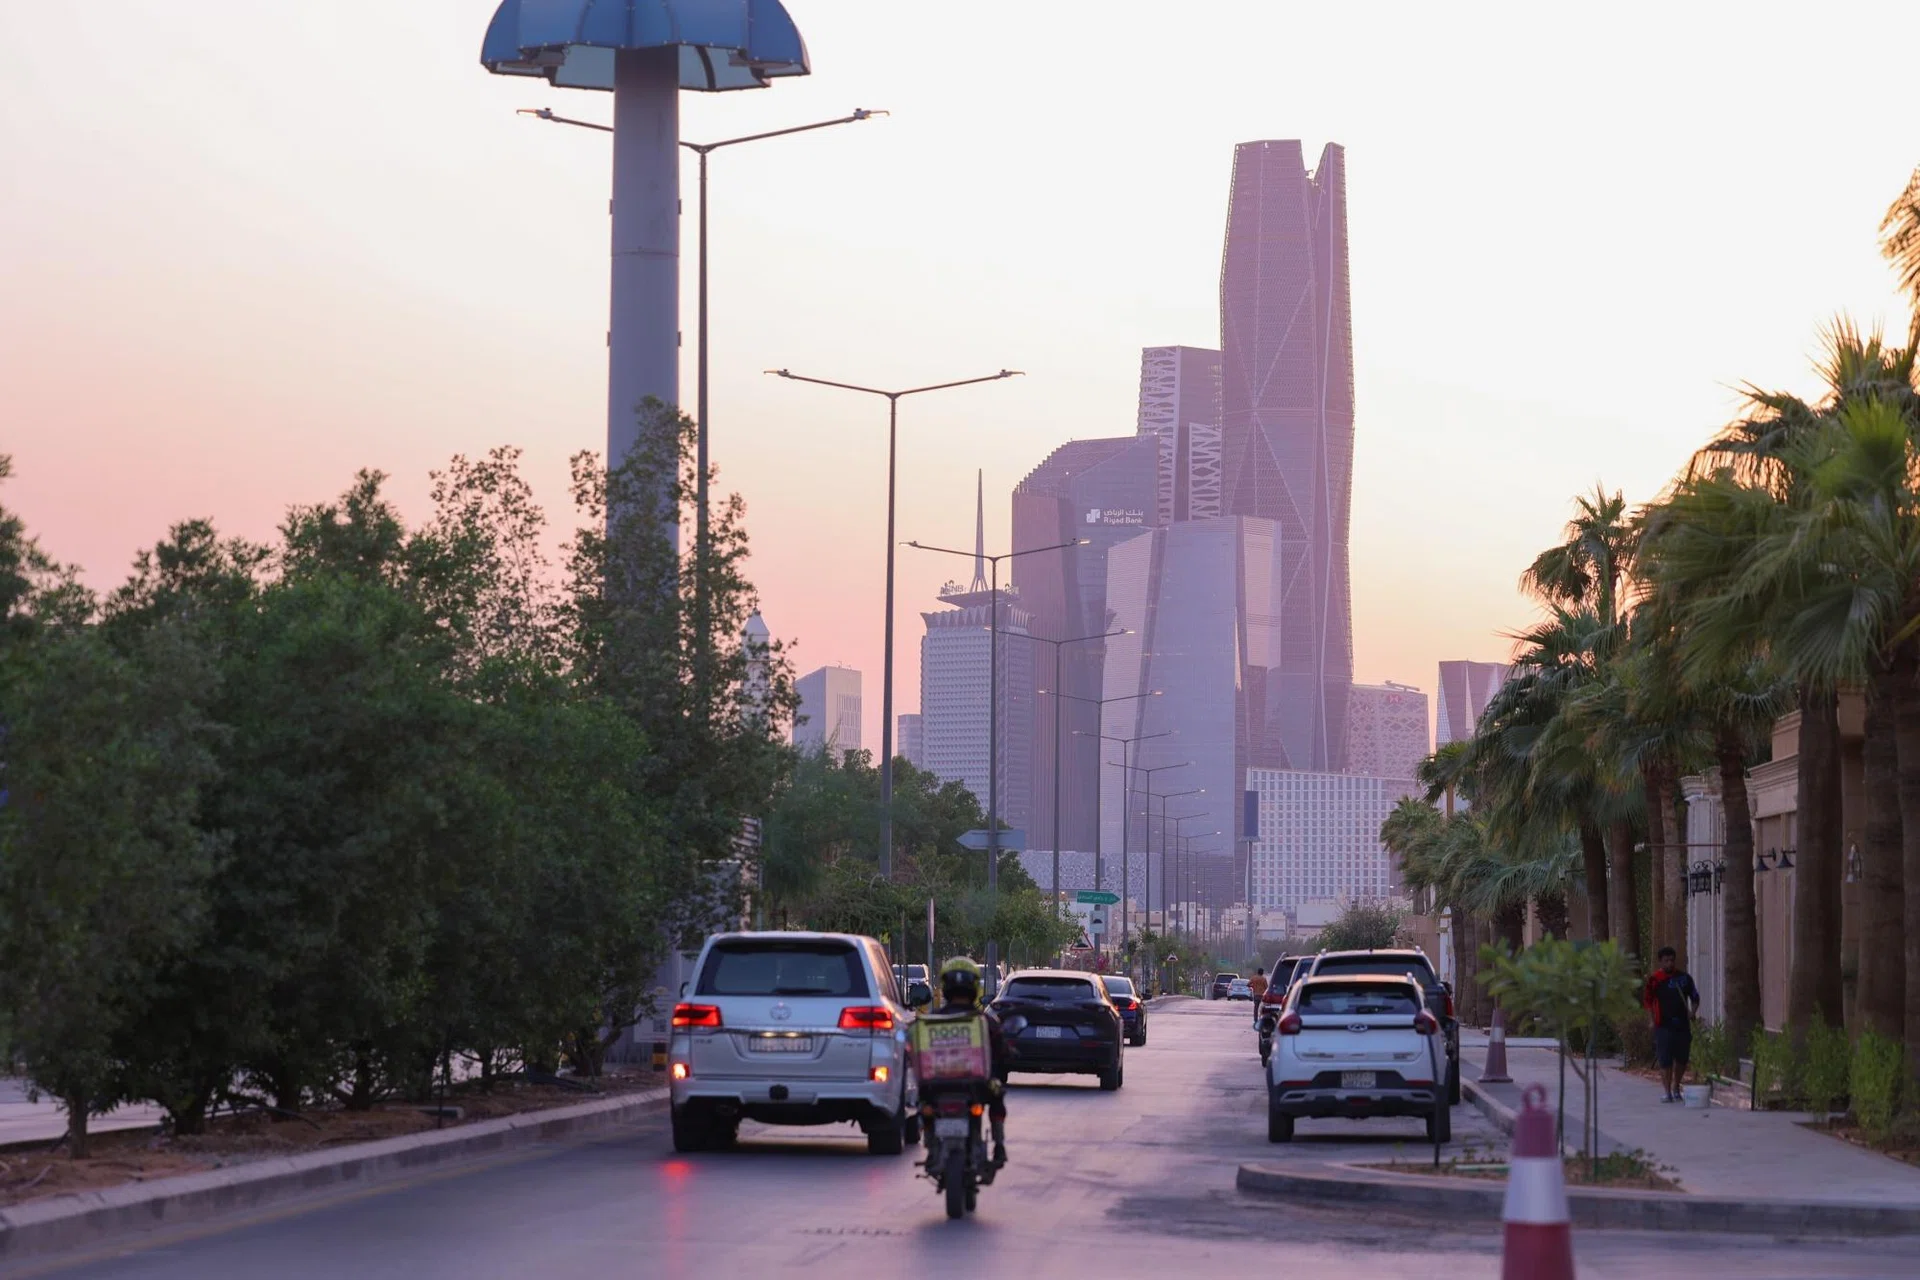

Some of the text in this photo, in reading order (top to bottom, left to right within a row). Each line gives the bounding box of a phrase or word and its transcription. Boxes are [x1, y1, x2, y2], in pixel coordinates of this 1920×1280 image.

[1103, 516, 1143, 525] Riyad Bank
[929, 1026, 971, 1039] noon
